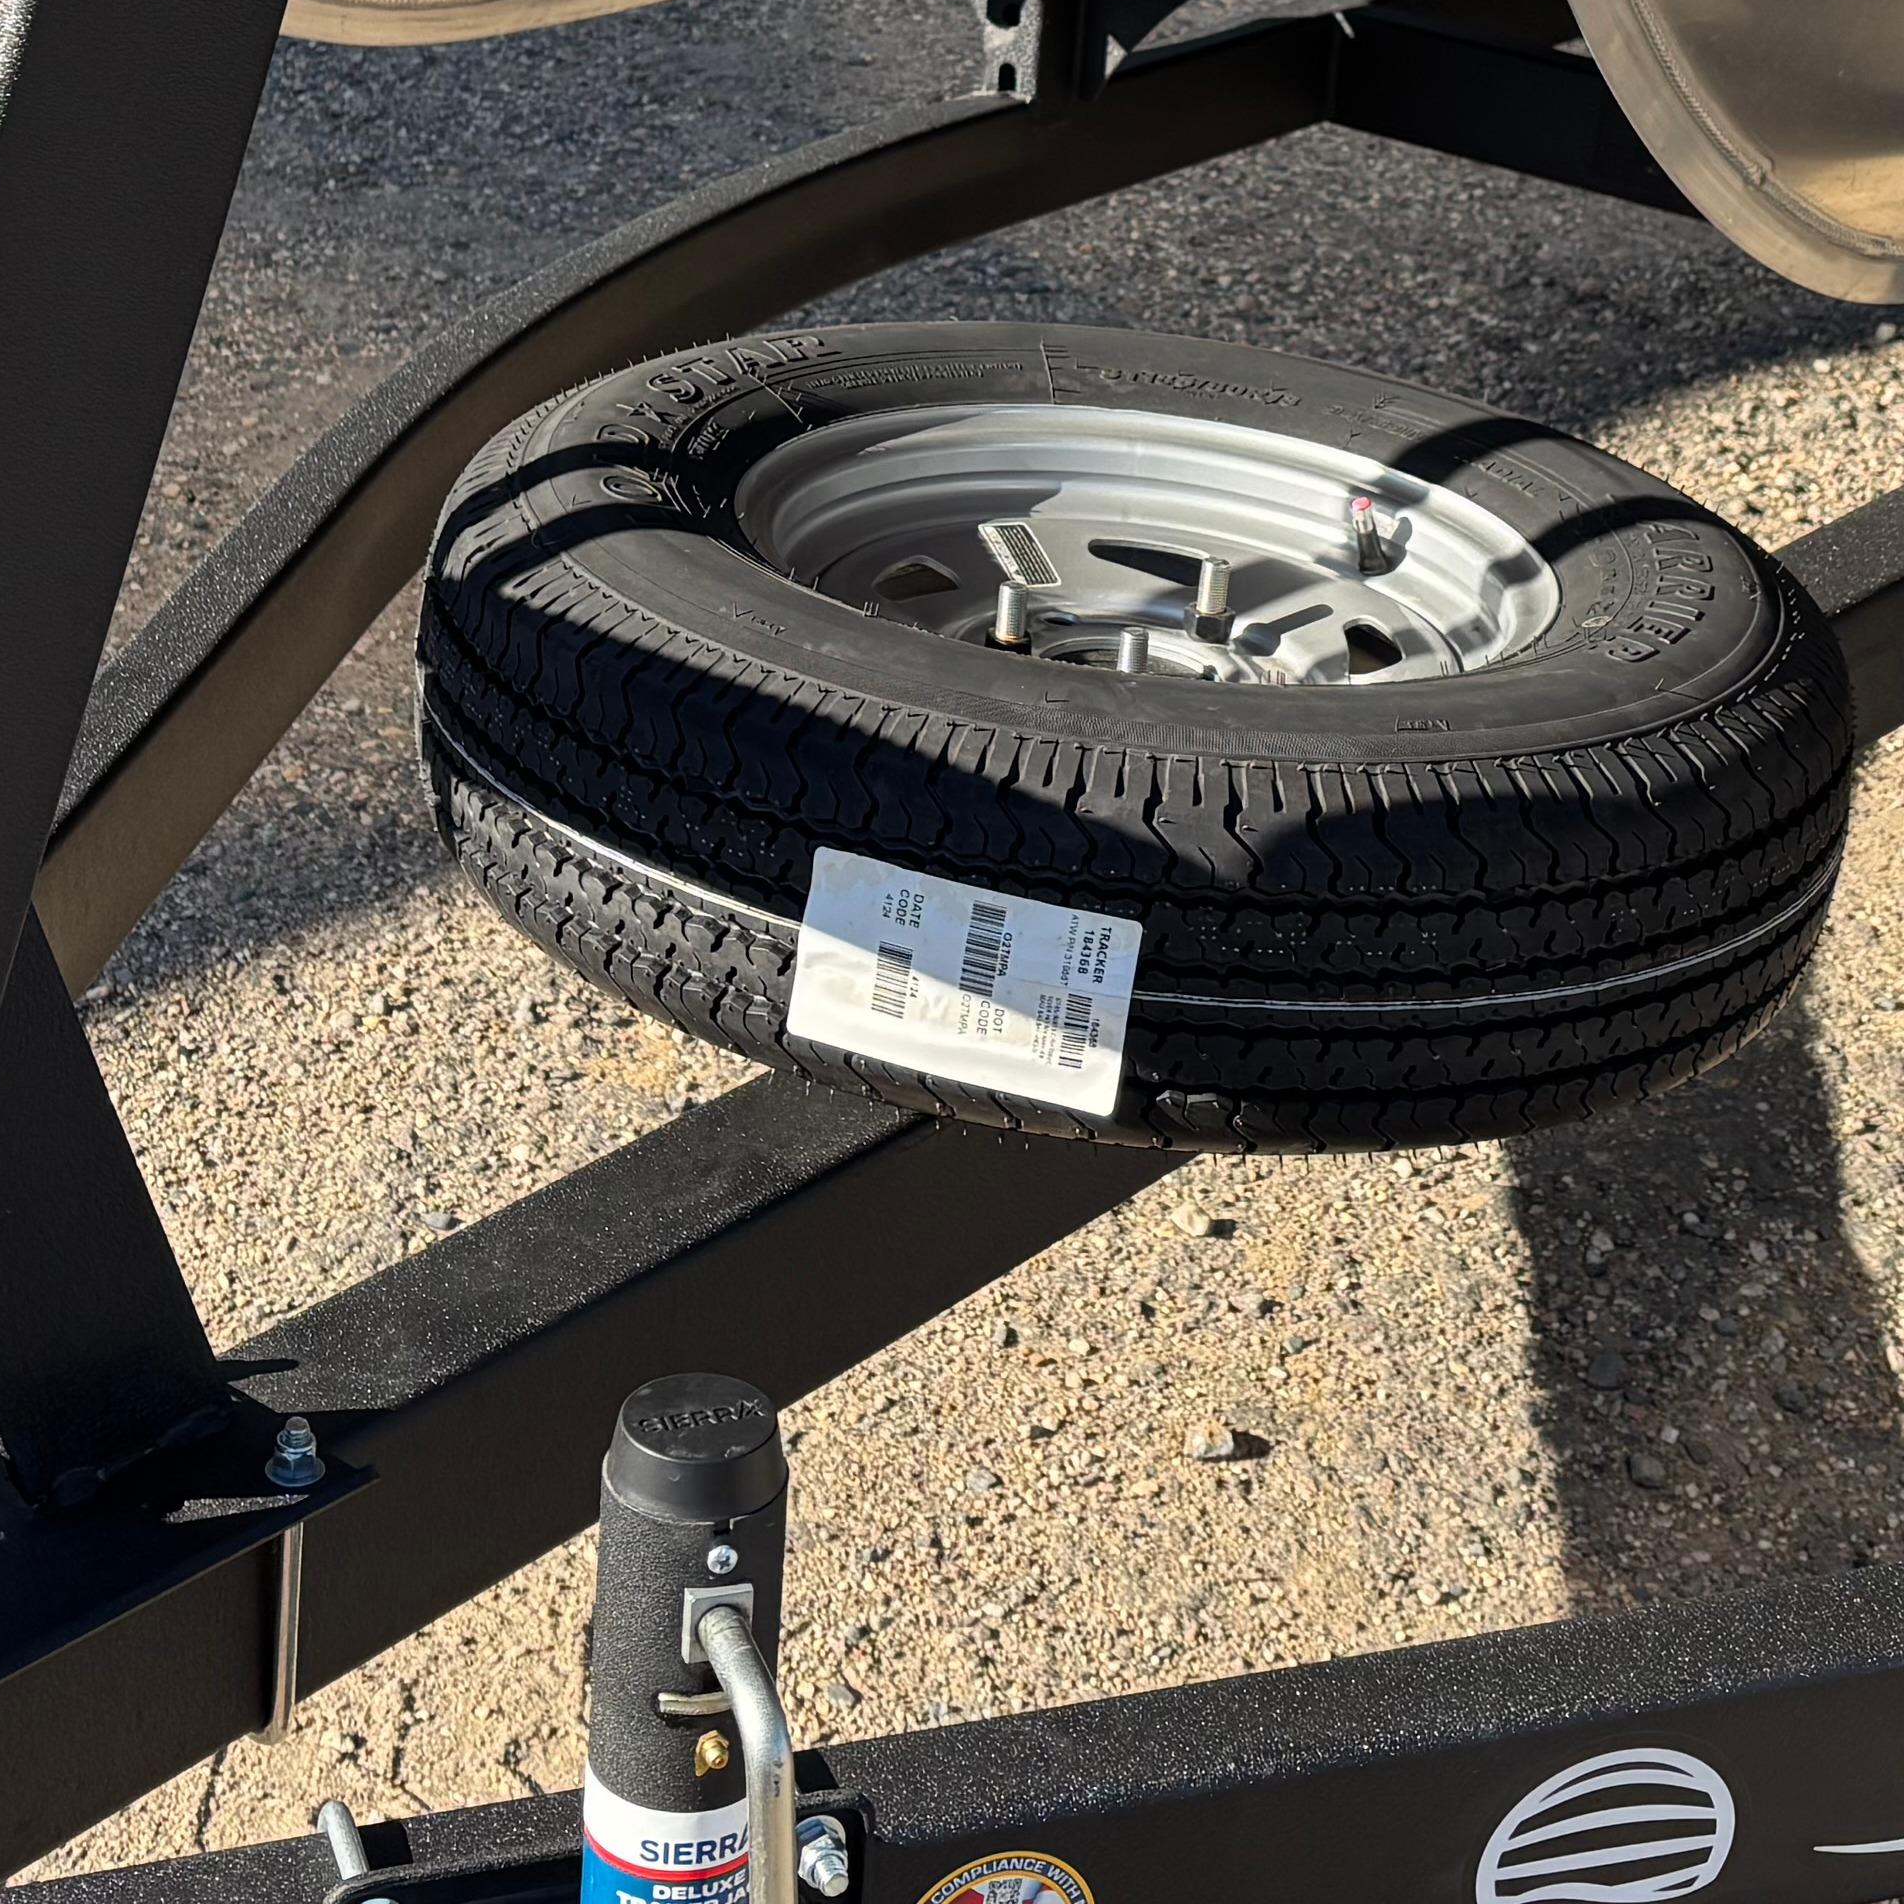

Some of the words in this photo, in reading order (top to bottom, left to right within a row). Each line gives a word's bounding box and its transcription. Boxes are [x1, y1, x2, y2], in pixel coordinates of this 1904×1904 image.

[882, 893, 894, 918] 4124
[895, 889, 910, 926] CODE
[909, 893, 925, 929] DATE
[1077, 930, 1095, 974] 184368
[1092, 927, 1112, 984] TRACKER
[976, 1000, 991, 1035] CODE
[993, 1008, 1005, 1034] DOT
[637, 1398, 766, 1434] SIERRA
[652, 1869, 746, 1900] DELUXE
[930, 1857, 1045, 1903] COMPLIANCE
[1046, 1866, 1082, 1898] WITH
